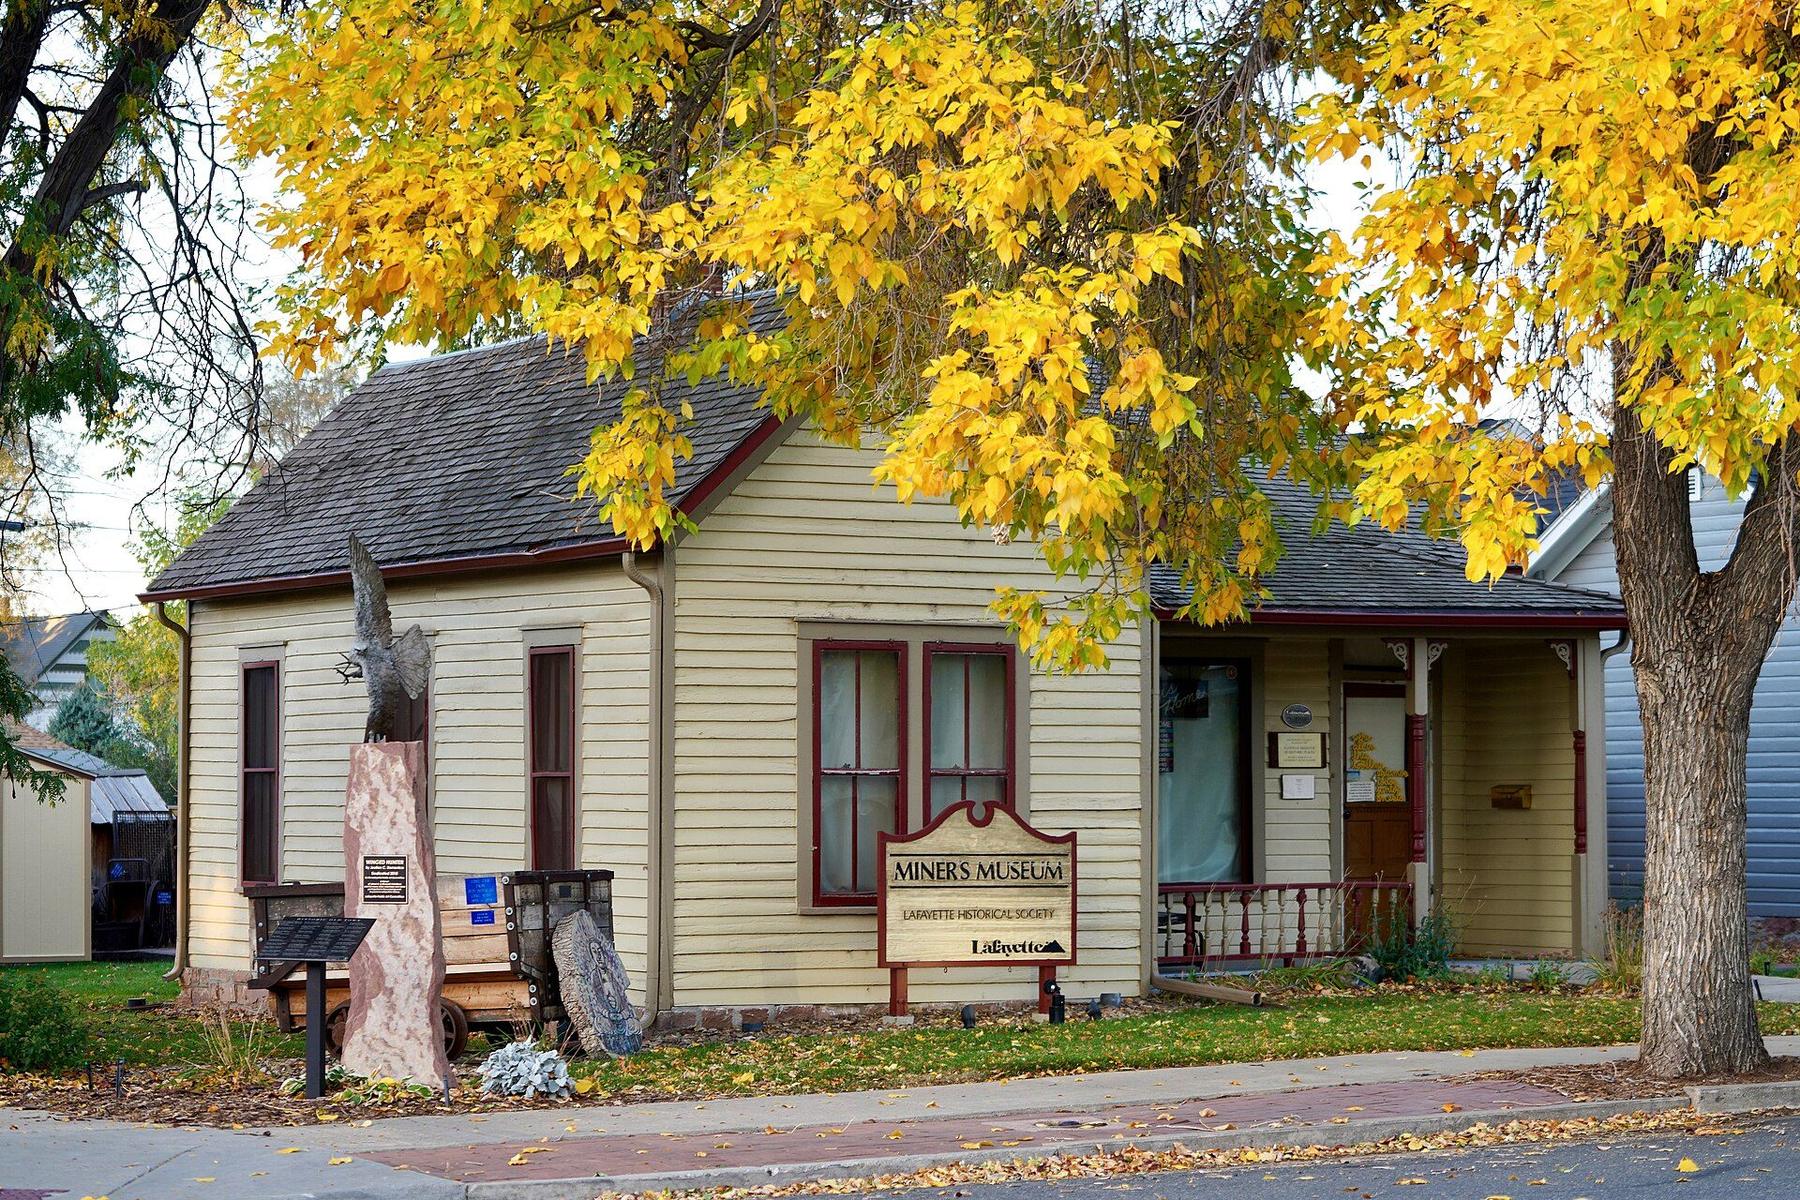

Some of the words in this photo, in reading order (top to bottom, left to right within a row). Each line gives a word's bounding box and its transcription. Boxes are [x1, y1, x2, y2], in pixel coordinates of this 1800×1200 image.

[976, 861, 1063, 880] MUSEUM
[903, 909, 955, 920] LAFAYETTE
[957, 909, 1013, 920] HISTORICAL
[1015, 908, 1055, 919] SOCIETY
[971, 939, 1043, 957] Lafayette
